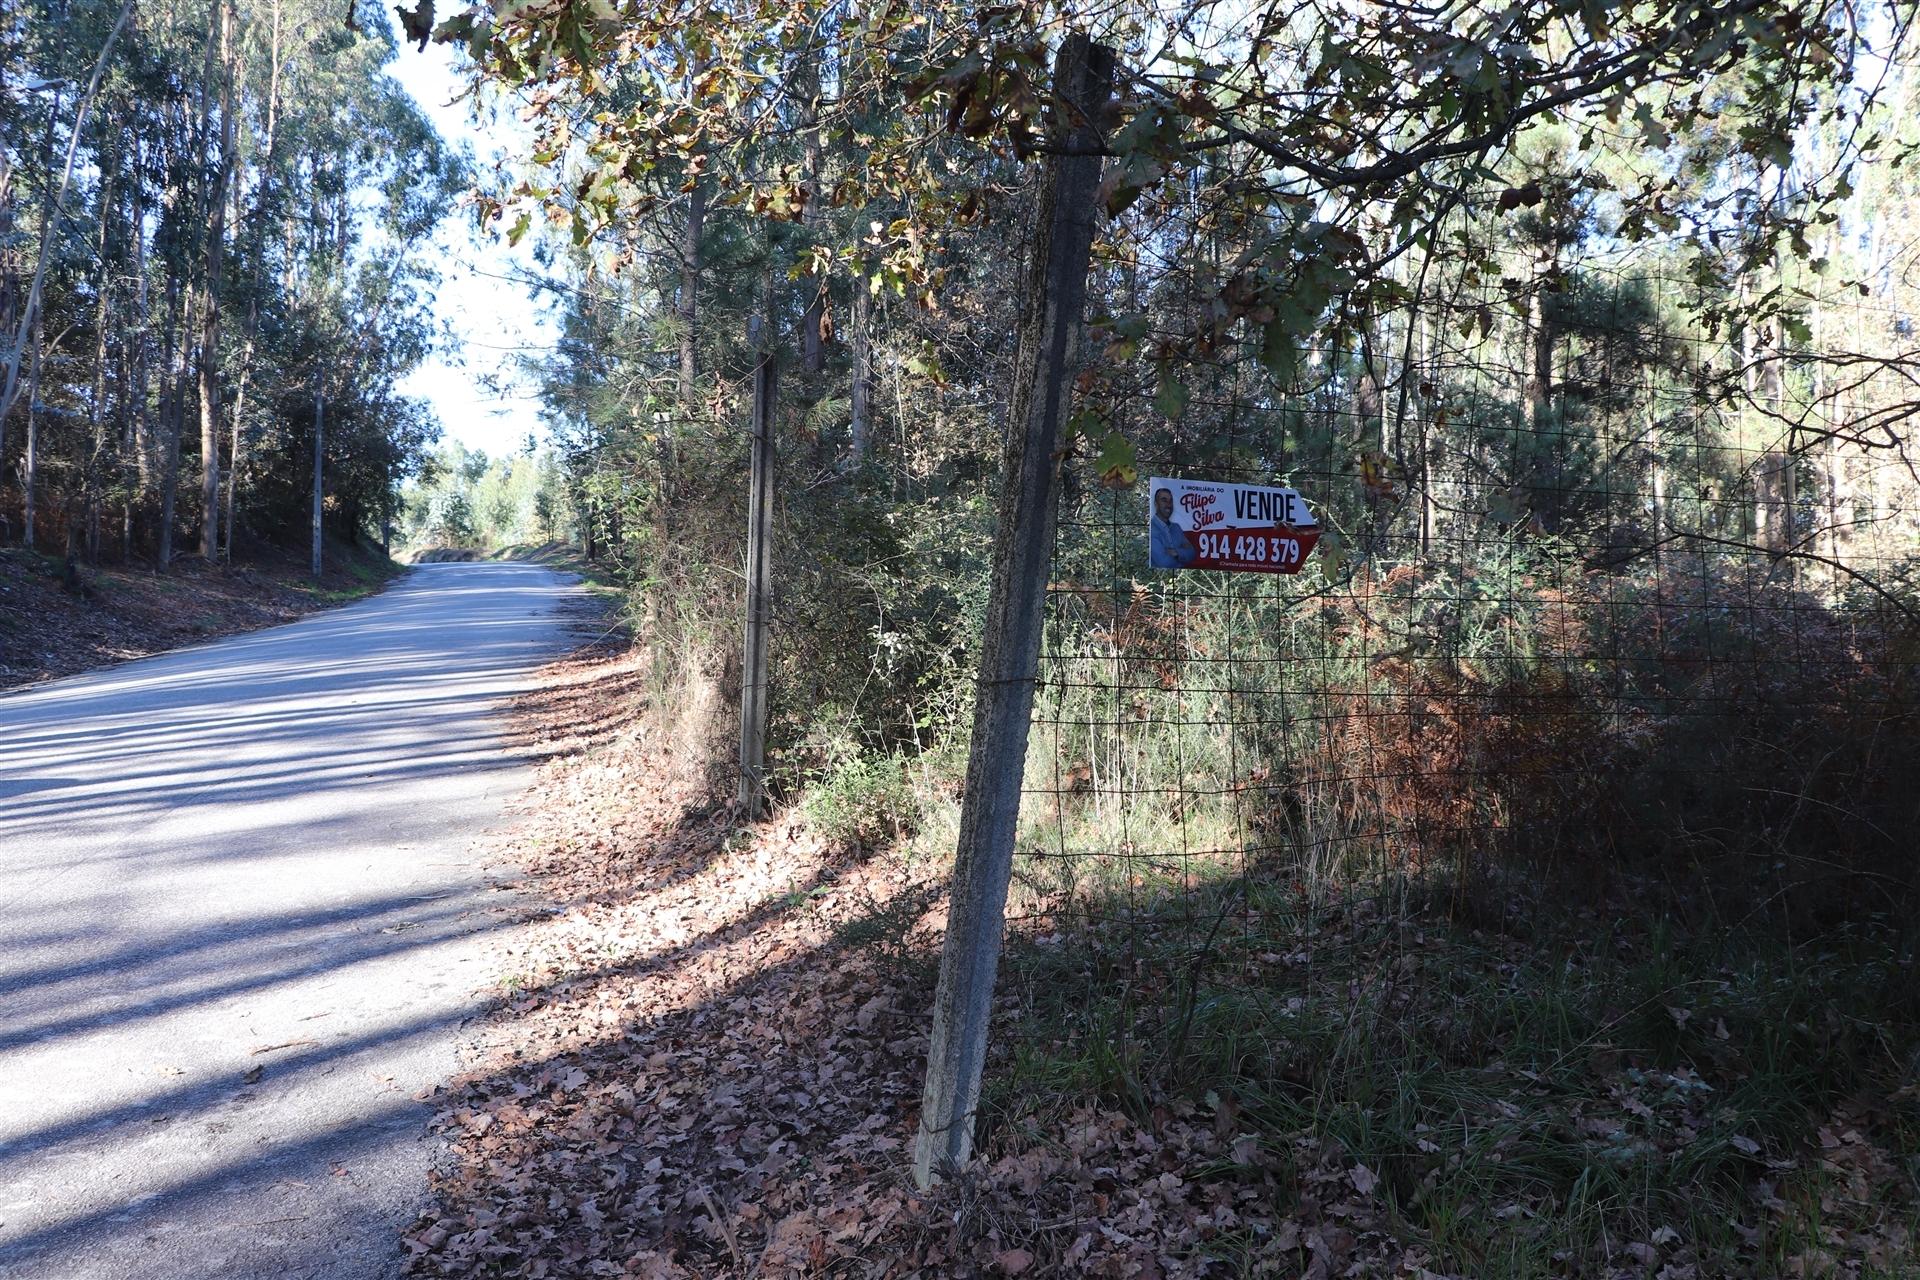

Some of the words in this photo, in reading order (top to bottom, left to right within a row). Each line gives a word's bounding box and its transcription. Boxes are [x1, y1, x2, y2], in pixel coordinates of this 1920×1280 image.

[1180, 493, 1216, 513] Filipe
[1234, 489, 1296, 522] VENDE
[1192, 509, 1225, 531] Silva
[1199, 533, 1231, 559] 914
[1235, 535, 1266, 562] 428
[1270, 537, 1300, 564] 379
